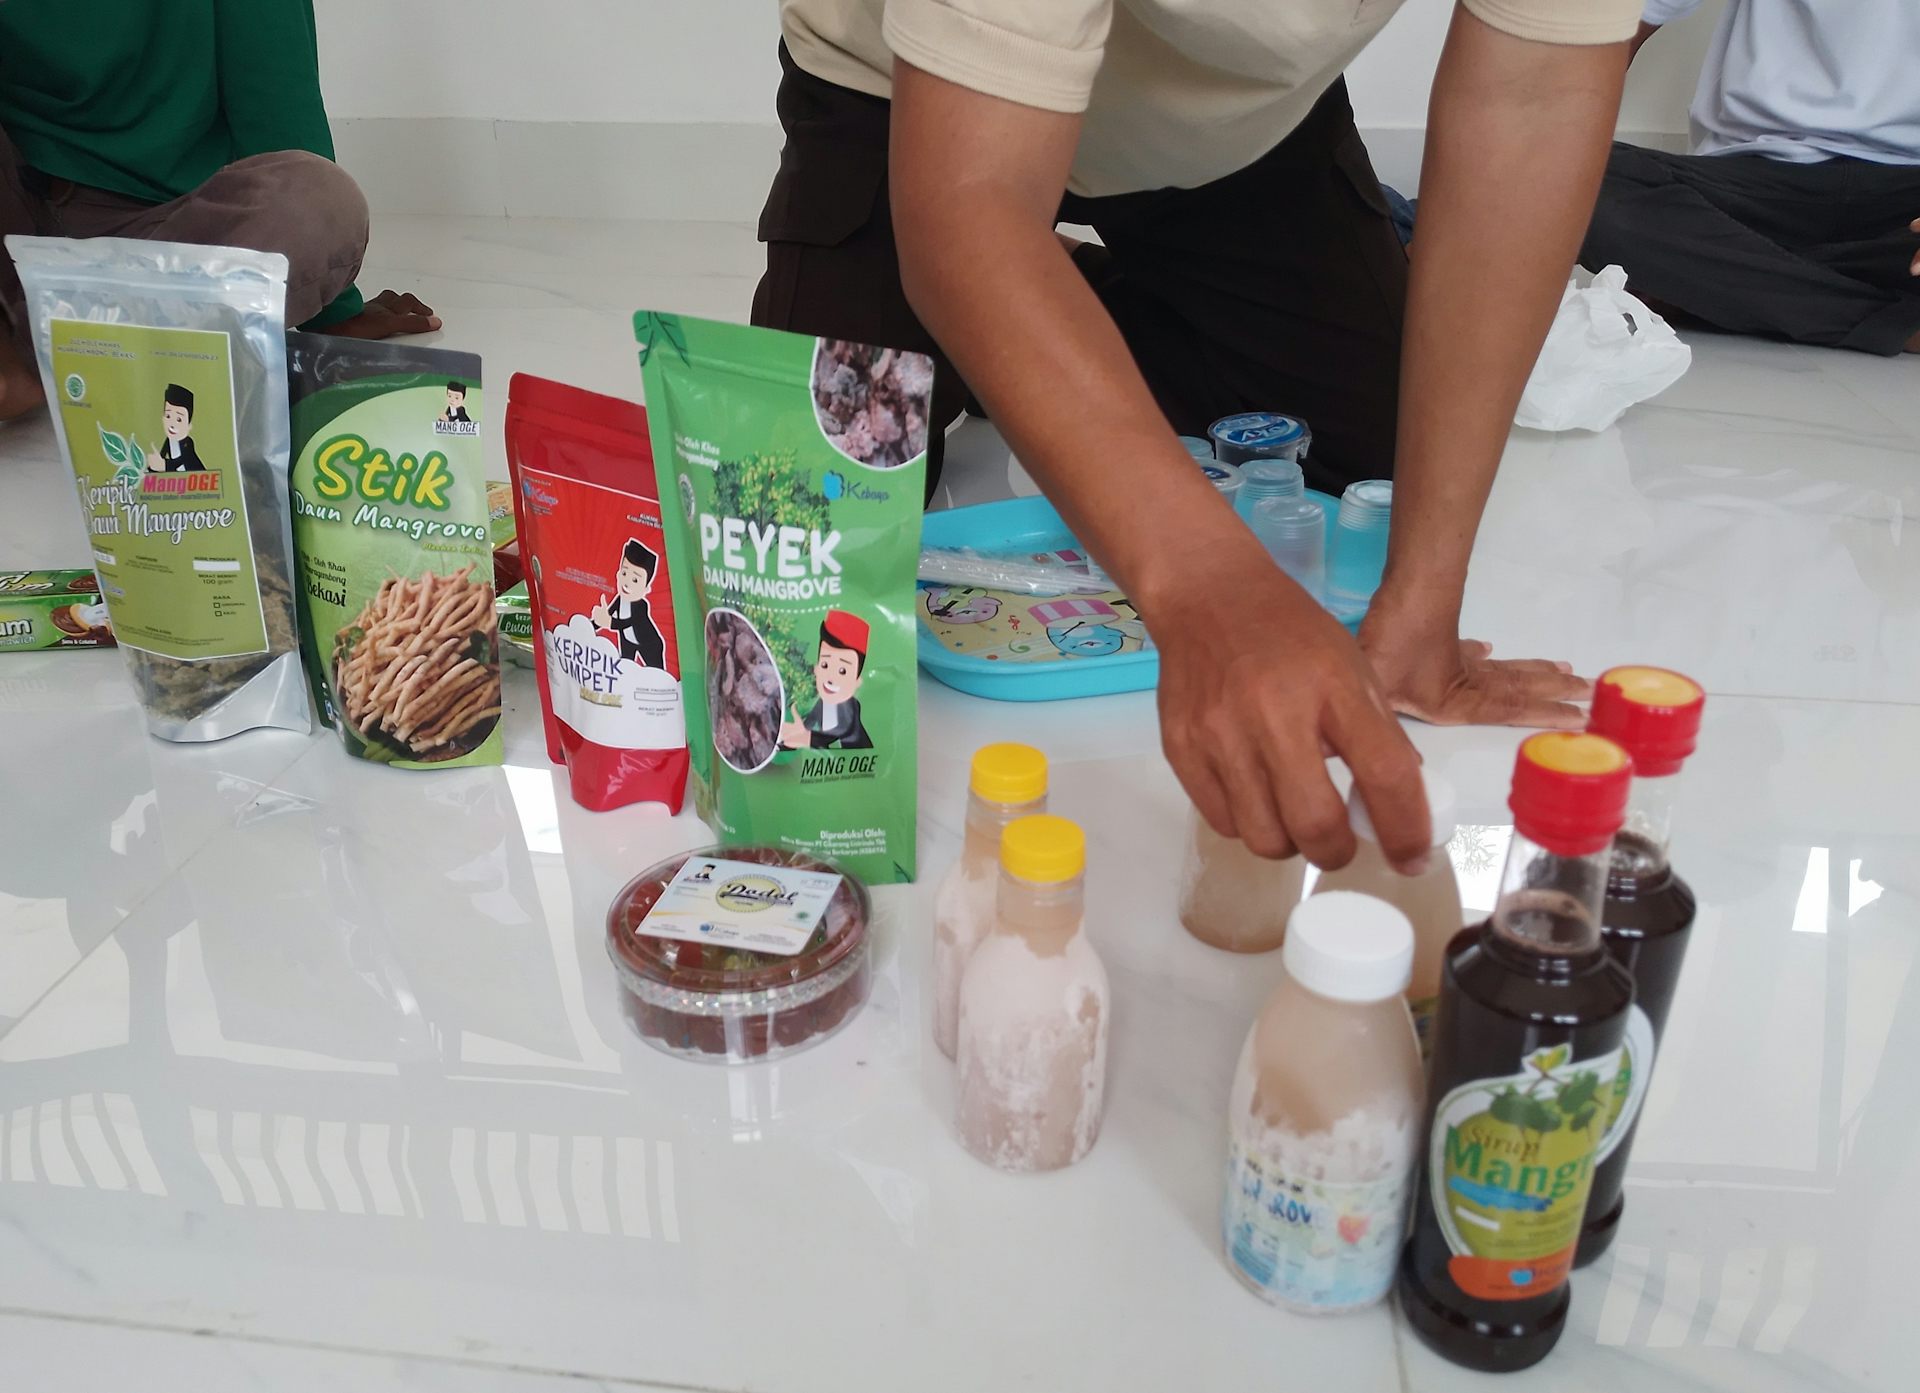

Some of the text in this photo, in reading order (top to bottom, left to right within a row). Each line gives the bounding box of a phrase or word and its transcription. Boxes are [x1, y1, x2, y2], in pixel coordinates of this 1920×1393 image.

[435, 422, 477, 433] MANG OGE
[143, 473, 219, 496] MangOGE
[315, 436, 451, 509] Stik
[77, 474, 136, 515] Keripik
[84, 504, 236, 545] Daun Mangrove
[294, 490, 342, 522] Daun
[352, 504, 486, 541] Mangrove
[700, 513, 842, 578] PEYEK
[306, 575, 346, 607] Bekasi
[703, 565, 842, 601] DAUN MANGROVE
[553, 636, 623, 675] KERIPIK
[558, 656, 618, 693] UMPET
[801, 755, 878, 778] MANG OGE
[820, 829, 863, 841] Diproduksi
[1470, 1127, 1541, 1162] Sirup
